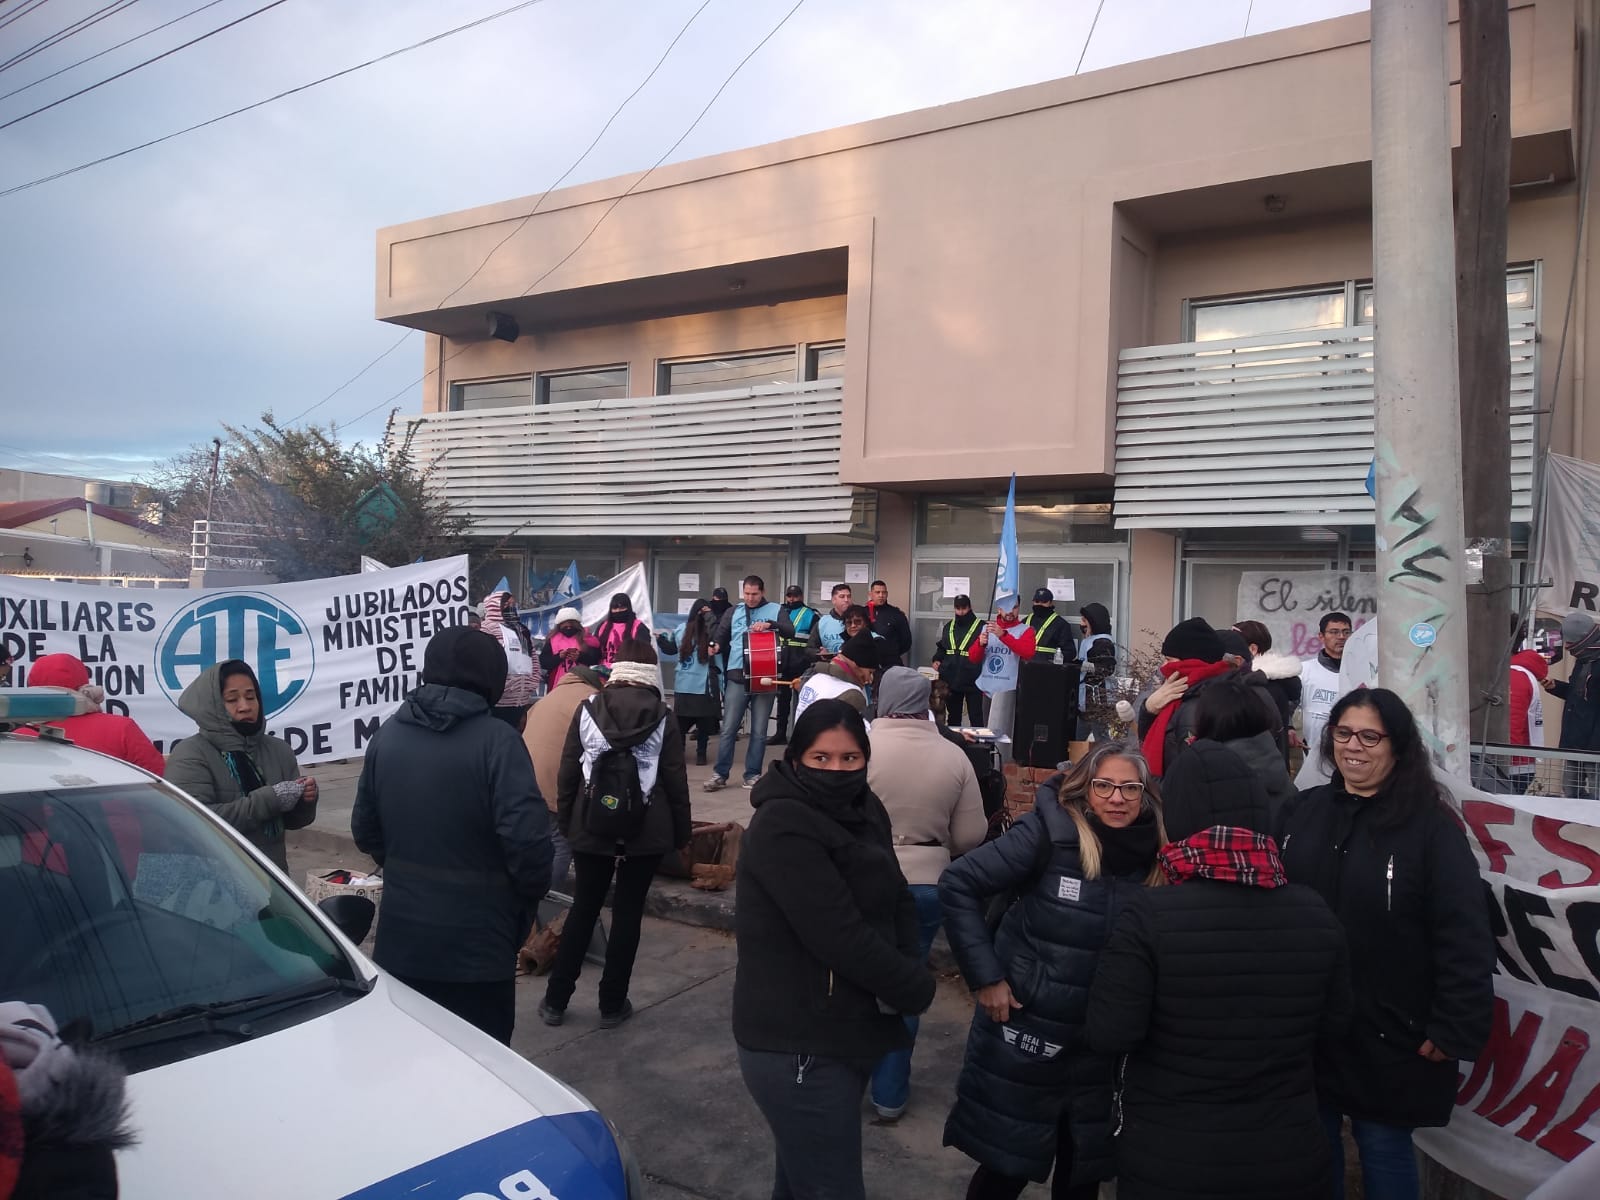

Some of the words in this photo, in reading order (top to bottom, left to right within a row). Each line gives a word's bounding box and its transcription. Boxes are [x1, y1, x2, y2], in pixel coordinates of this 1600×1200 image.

[325, 576, 468, 622] JUBILADOS
[1259, 578, 1298, 613] El
[1306, 576, 1377, 614] silen
[3, 632, 47, 663] DE
[79, 634, 117, 662] LA
[323, 606, 469, 652] MINISTERIO
[160, 595, 304, 717] ATE
[376, 643, 416, 674] DE
[284, 722, 333, 756] DE
[1022, 1033, 1040, 1047] REAL
[1456, 996, 1600, 1162] NAL
